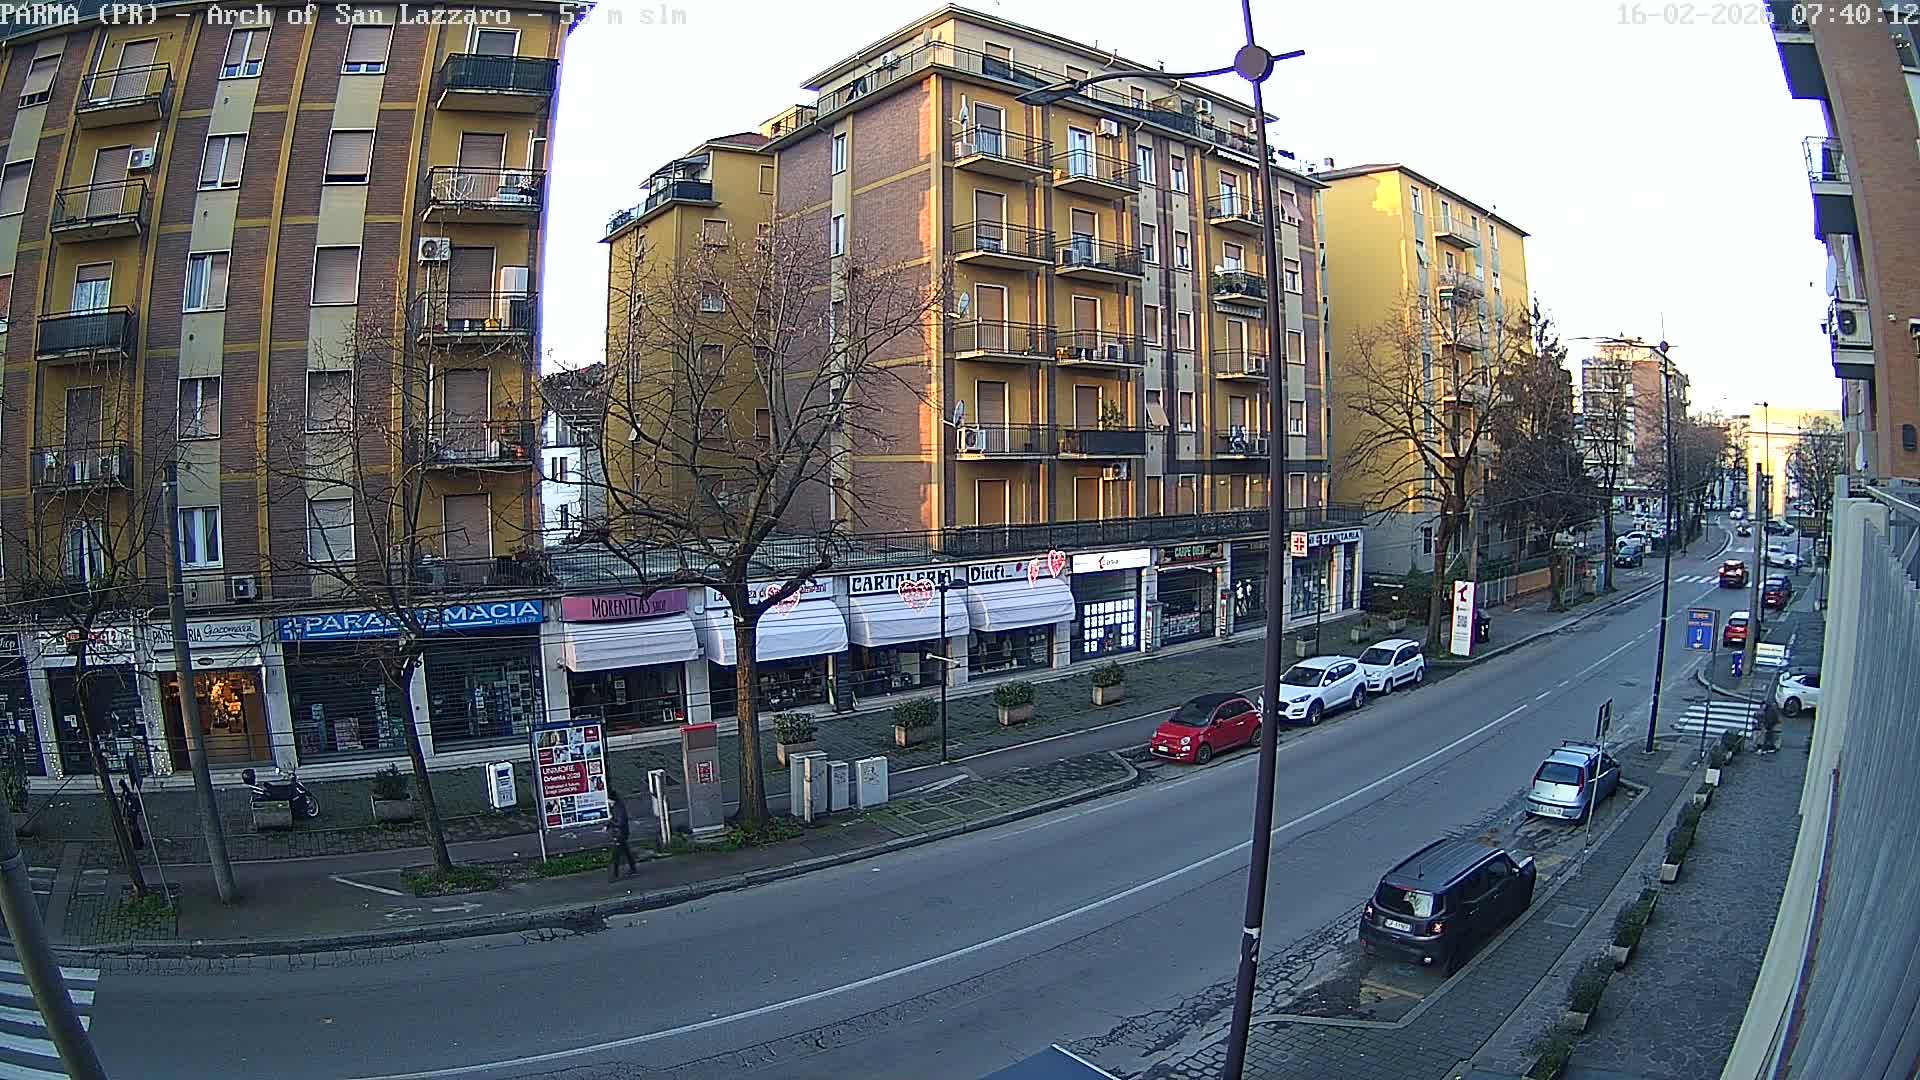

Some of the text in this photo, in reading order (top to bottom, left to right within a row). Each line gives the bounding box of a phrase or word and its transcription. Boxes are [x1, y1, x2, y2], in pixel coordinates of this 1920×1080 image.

[852, 570, 952, 592] CARTOLERIA
[303, 601, 539, 632] PARARMACIA
[592, 598, 650, 618] MORENITAS
[152, 628, 204, 643] PANERIA
